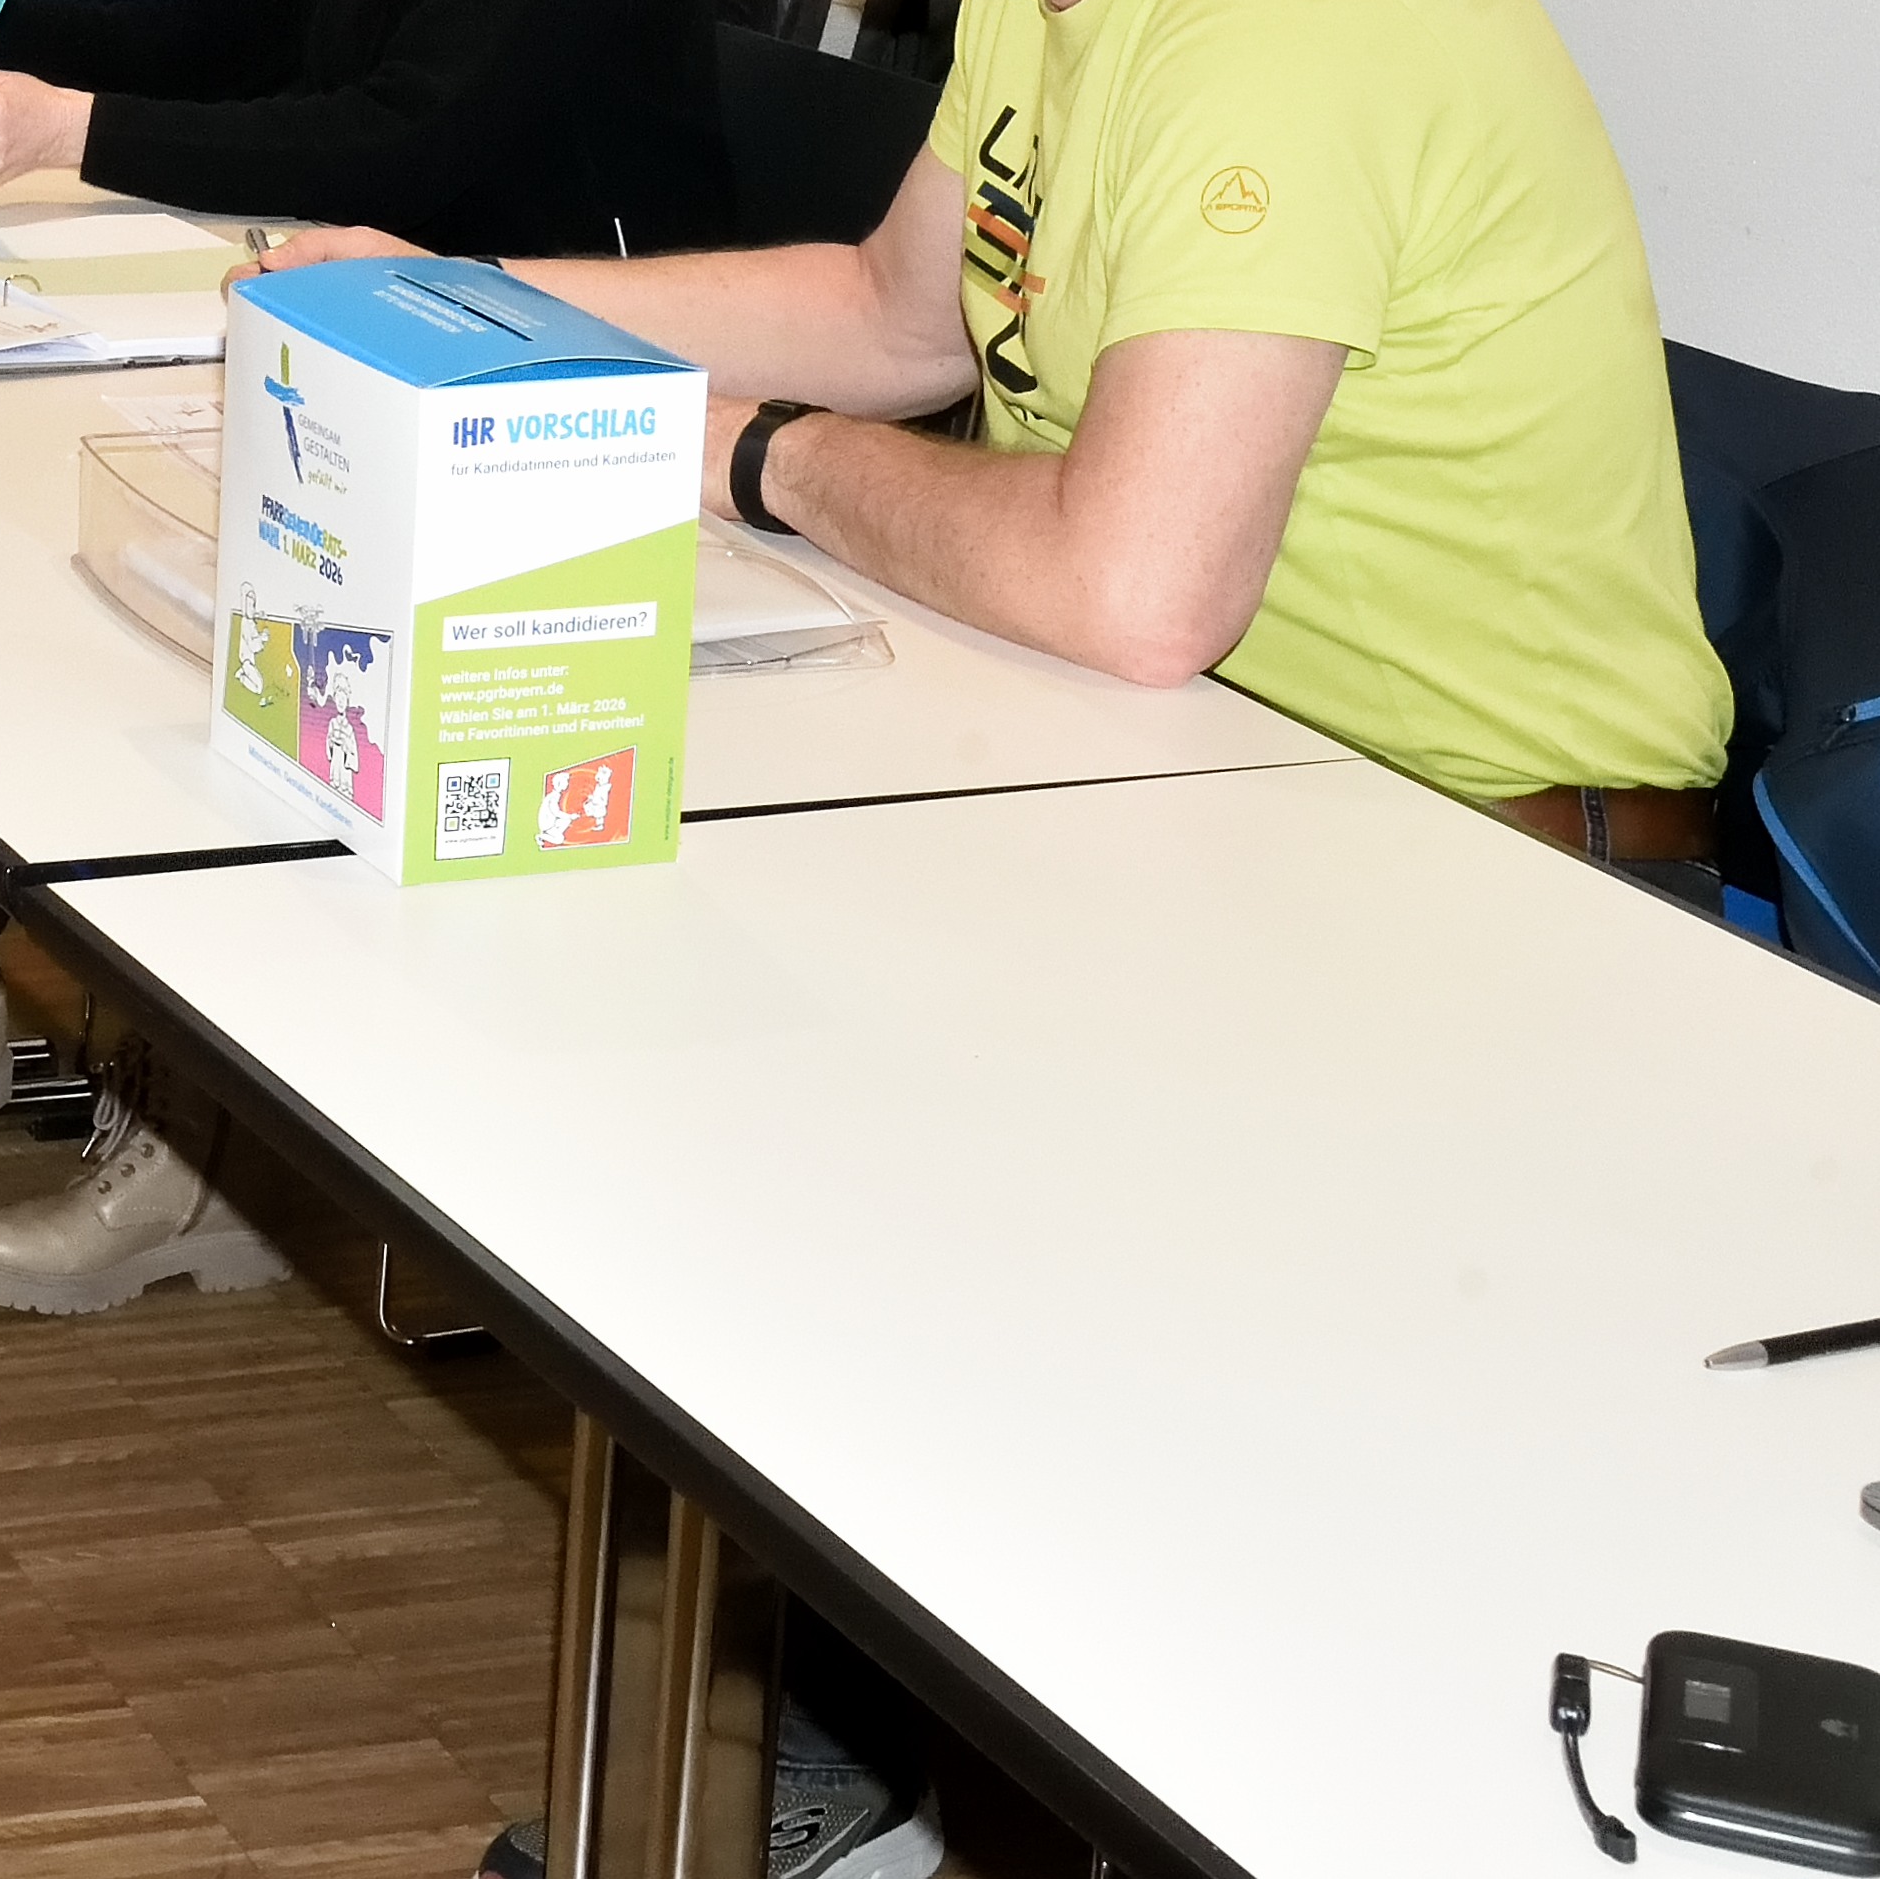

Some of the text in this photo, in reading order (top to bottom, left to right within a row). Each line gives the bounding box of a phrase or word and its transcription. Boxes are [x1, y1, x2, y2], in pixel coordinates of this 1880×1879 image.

[298, 413, 341, 446] GEMEINSAM
[453, 407, 656, 448] IHR VORSCHLAG
[304, 437, 350, 473] GESTALTEN
[451, 451, 677, 476] für Kandidatinnen und Kandidaten
[319, 554, 343, 586] 2026
[452, 611, 648, 641] Wer soll kandidieren?
[441, 670, 491, 685] weitere
[531, 665, 570, 678] unter:
[441, 681, 564, 703] www.pgrbayern.de
[440, 697, 627, 725] Wählen Sie am 1. März 2026
[439, 714, 645, 743] Ihre Favoritinnen und Favoriten!
